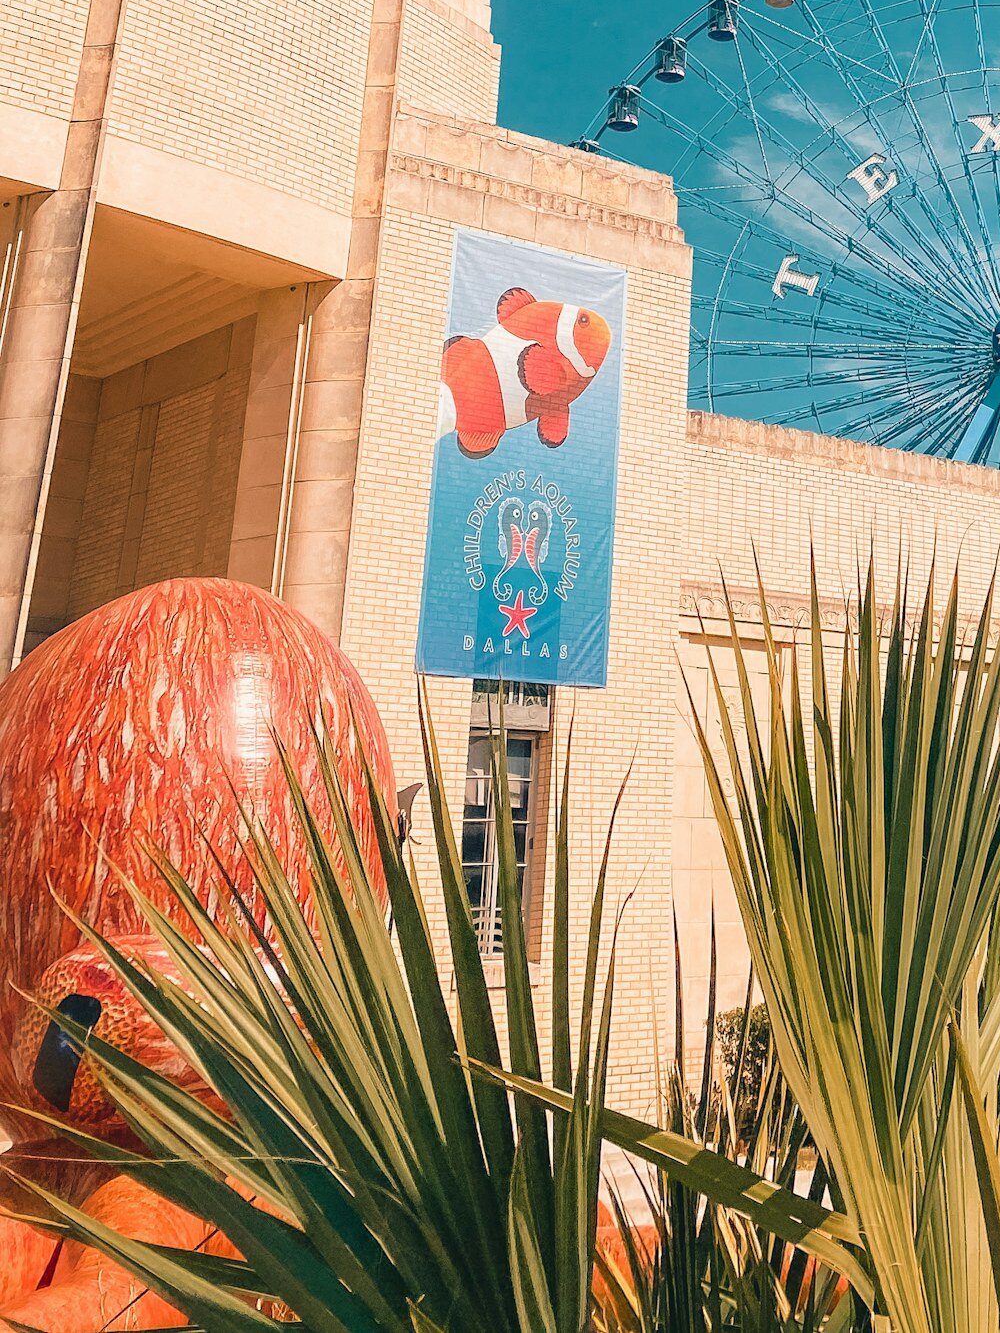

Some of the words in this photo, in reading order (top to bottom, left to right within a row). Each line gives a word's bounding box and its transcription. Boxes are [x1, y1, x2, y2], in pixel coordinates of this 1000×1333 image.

[463, 469, 526, 591] CHILDREN'S
[530, 473, 581, 602] AQUARIUM
[463, 634, 569, 659] DALLAS
